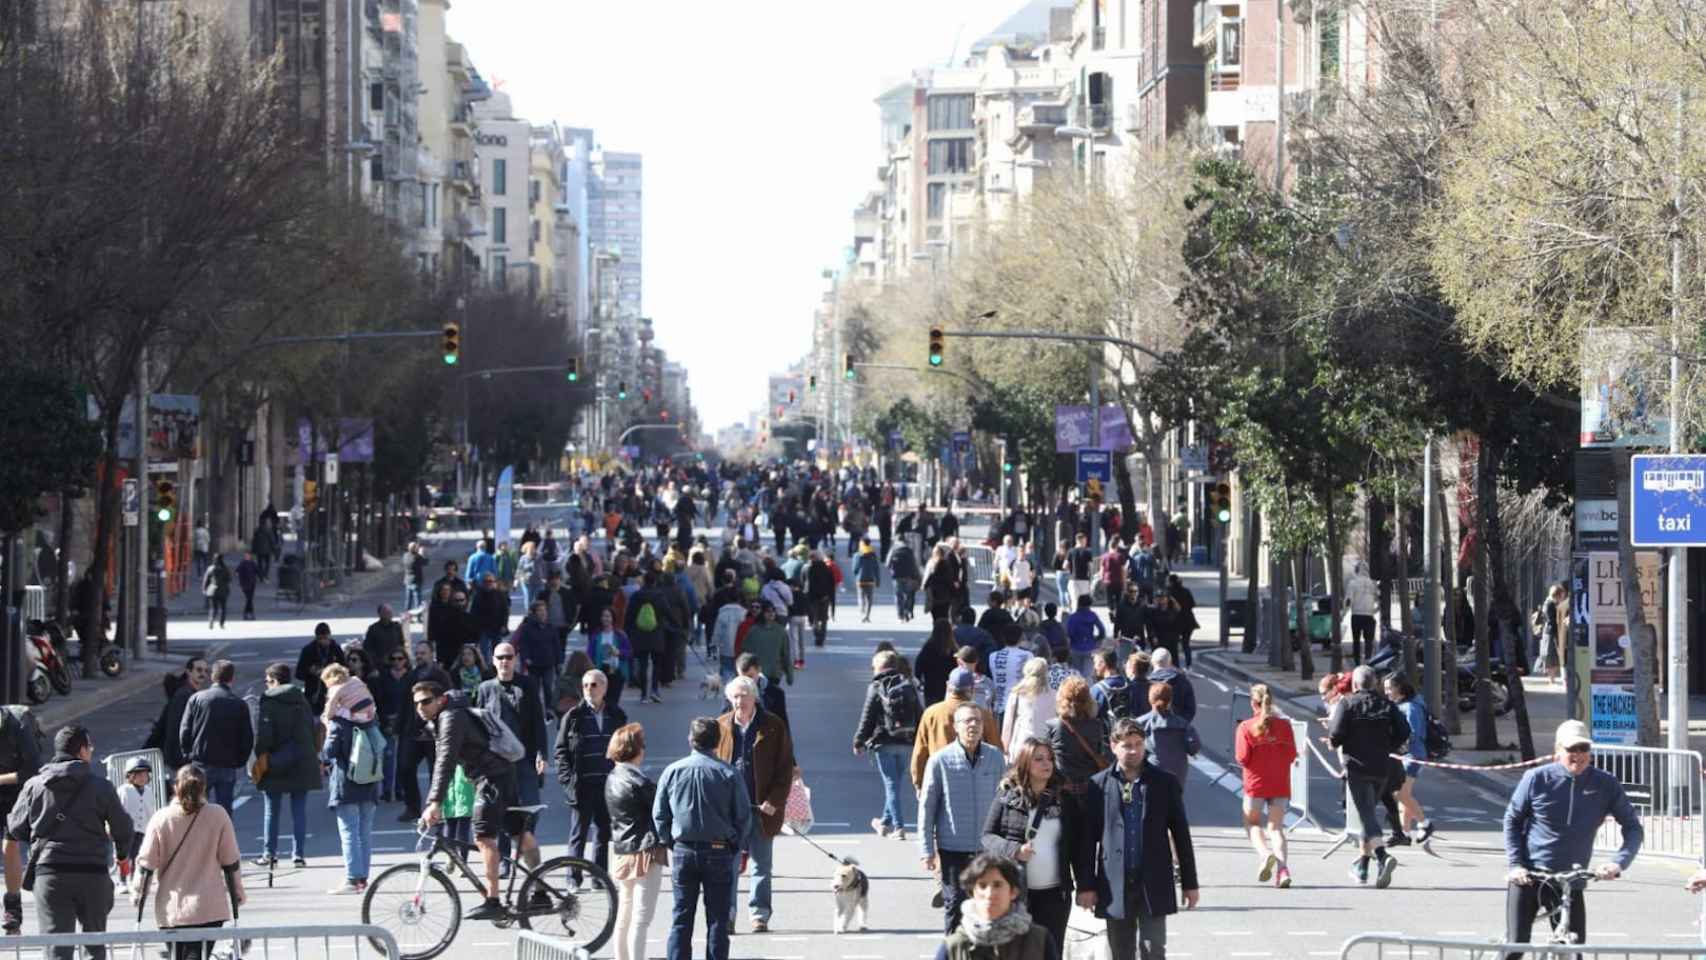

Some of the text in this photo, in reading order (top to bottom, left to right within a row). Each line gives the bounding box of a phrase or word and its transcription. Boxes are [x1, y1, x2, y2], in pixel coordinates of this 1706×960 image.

[1658, 513, 1691, 531] taxi
[1596, 581, 1657, 607] Llch
[1593, 694, 1636, 715] THE HACKER
[1593, 720, 1636, 729] KRIS BAHA
